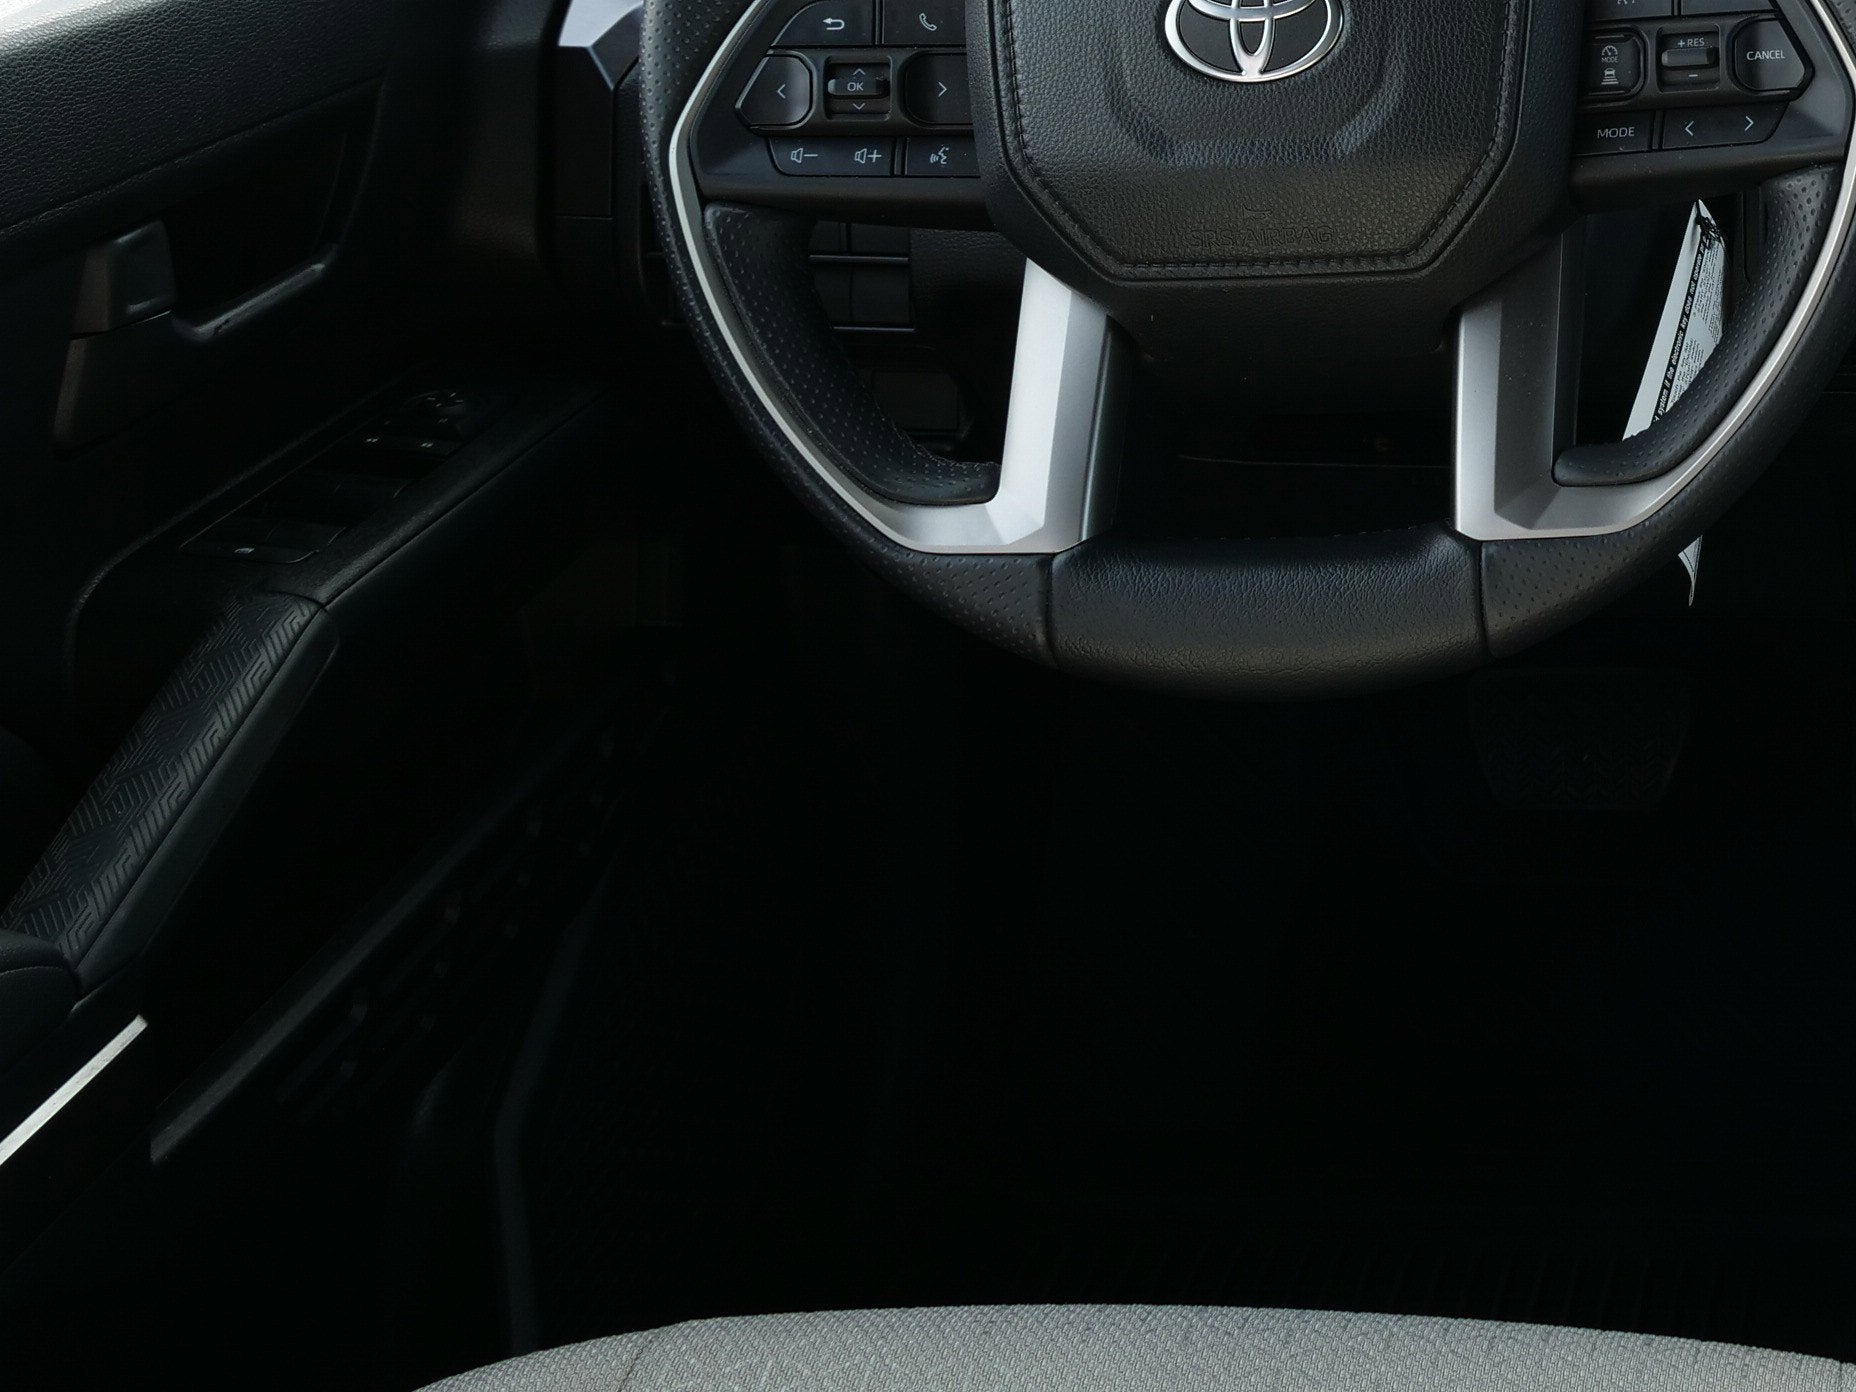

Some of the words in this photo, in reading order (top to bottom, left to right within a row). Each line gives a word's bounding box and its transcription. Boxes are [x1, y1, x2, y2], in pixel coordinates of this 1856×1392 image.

[1746, 50, 1786, 61] CANCEL
[847, 82, 864, 92] OK
[1597, 126, 1635, 138] MODE
[1693, 254, 1703, 281] operate
[1684, 295, 1693, 314] does
[1680, 315, 1689, 329] key
[1671, 330, 1684, 365] electronic
[1666, 366, 1675, 380] the
[1657, 389, 1669, 416] system
